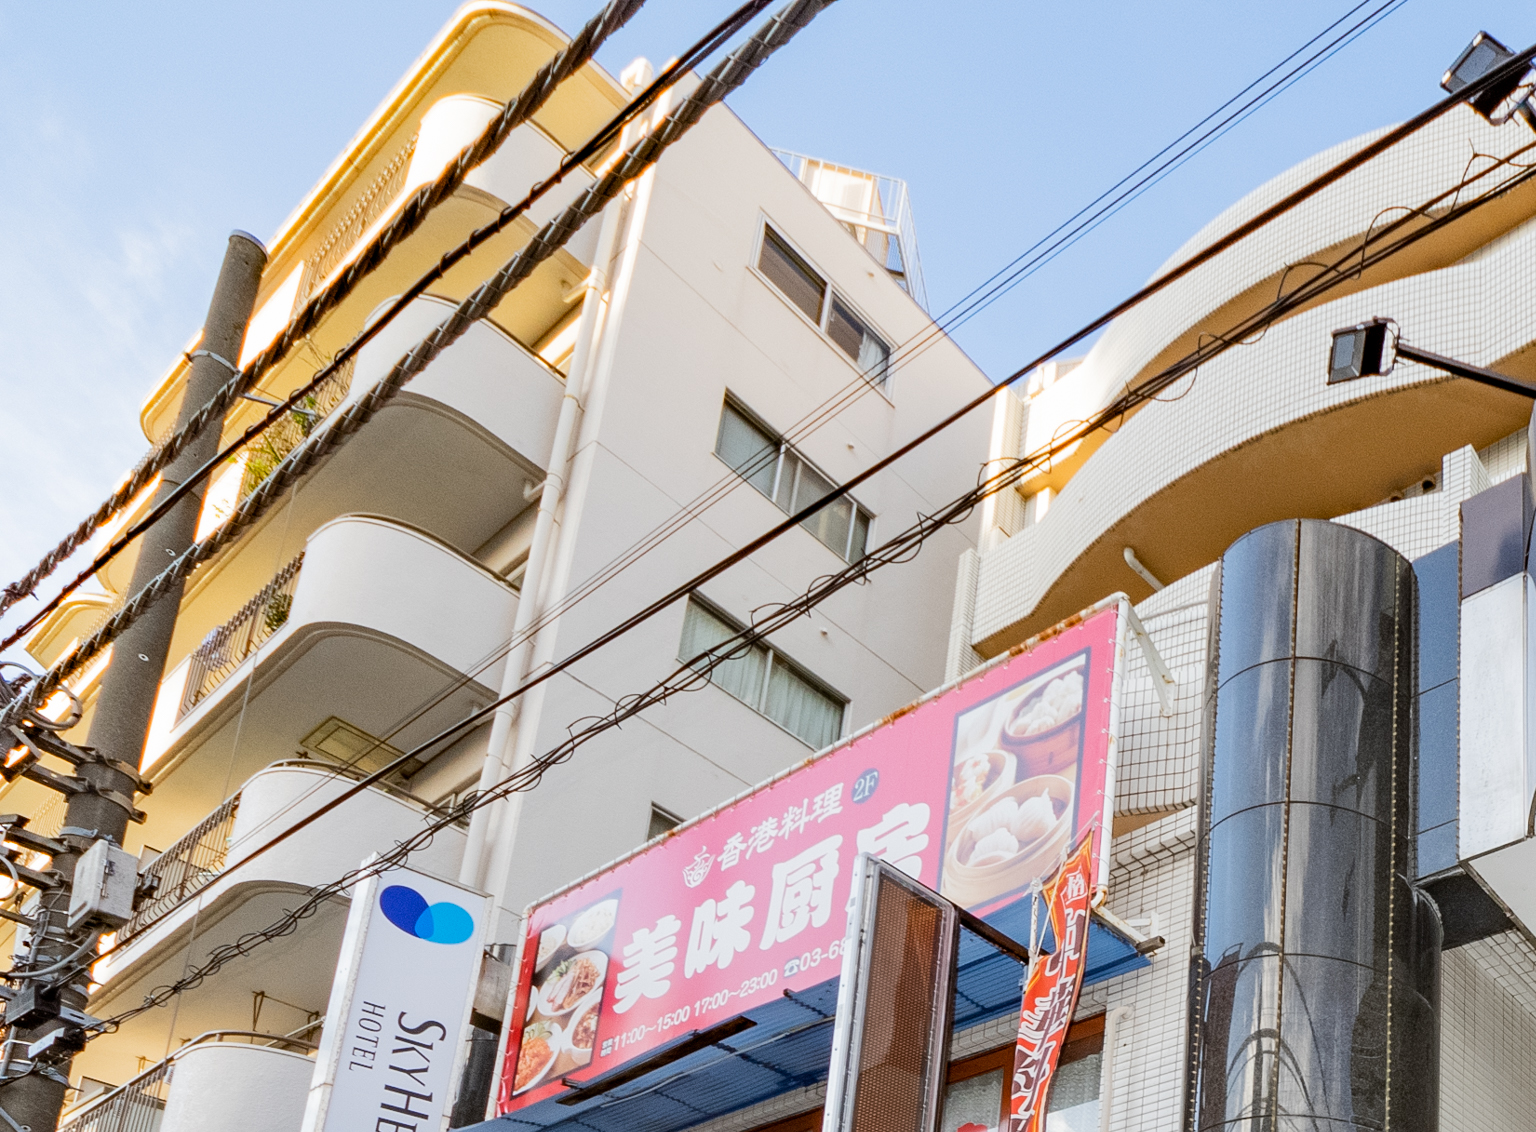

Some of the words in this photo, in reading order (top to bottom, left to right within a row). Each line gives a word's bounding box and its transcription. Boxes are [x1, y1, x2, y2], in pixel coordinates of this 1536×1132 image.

[852, 771, 878, 801] 2F
[717, 782, 844, 871] 香港料理
[349, 1000, 386, 1071] HOTEL
